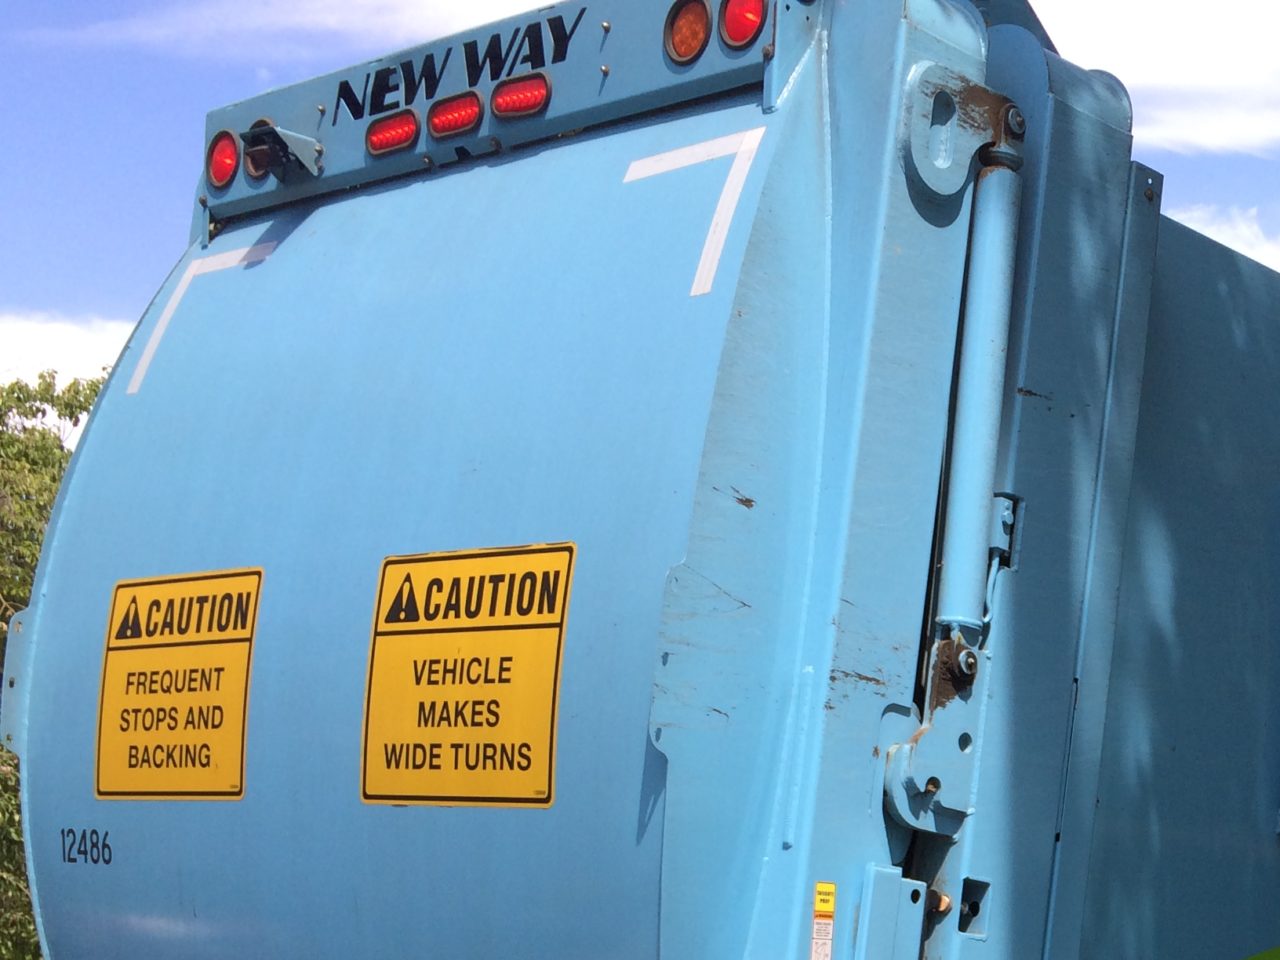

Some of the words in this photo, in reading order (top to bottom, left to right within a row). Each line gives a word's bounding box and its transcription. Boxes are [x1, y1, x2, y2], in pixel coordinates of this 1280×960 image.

[331, 47, 453, 127] NEW
[463, 7, 587, 87] WAY
[424, 570, 561, 621] CAUTION
[145, 591, 251, 637] CAUTION
[125, 667, 225, 696] FREQUENT
[413, 656, 513, 687] VEHICLE
[119, 708, 180, 733] STOPS
[184, 705, 224, 730] AND
[417, 700, 500, 728] MAKES
[128, 744, 211, 769] BACKING
[384, 744, 442, 771] WIDE
[451, 743, 532, 772] TURNS
[61, 828, 113, 865] 12486
